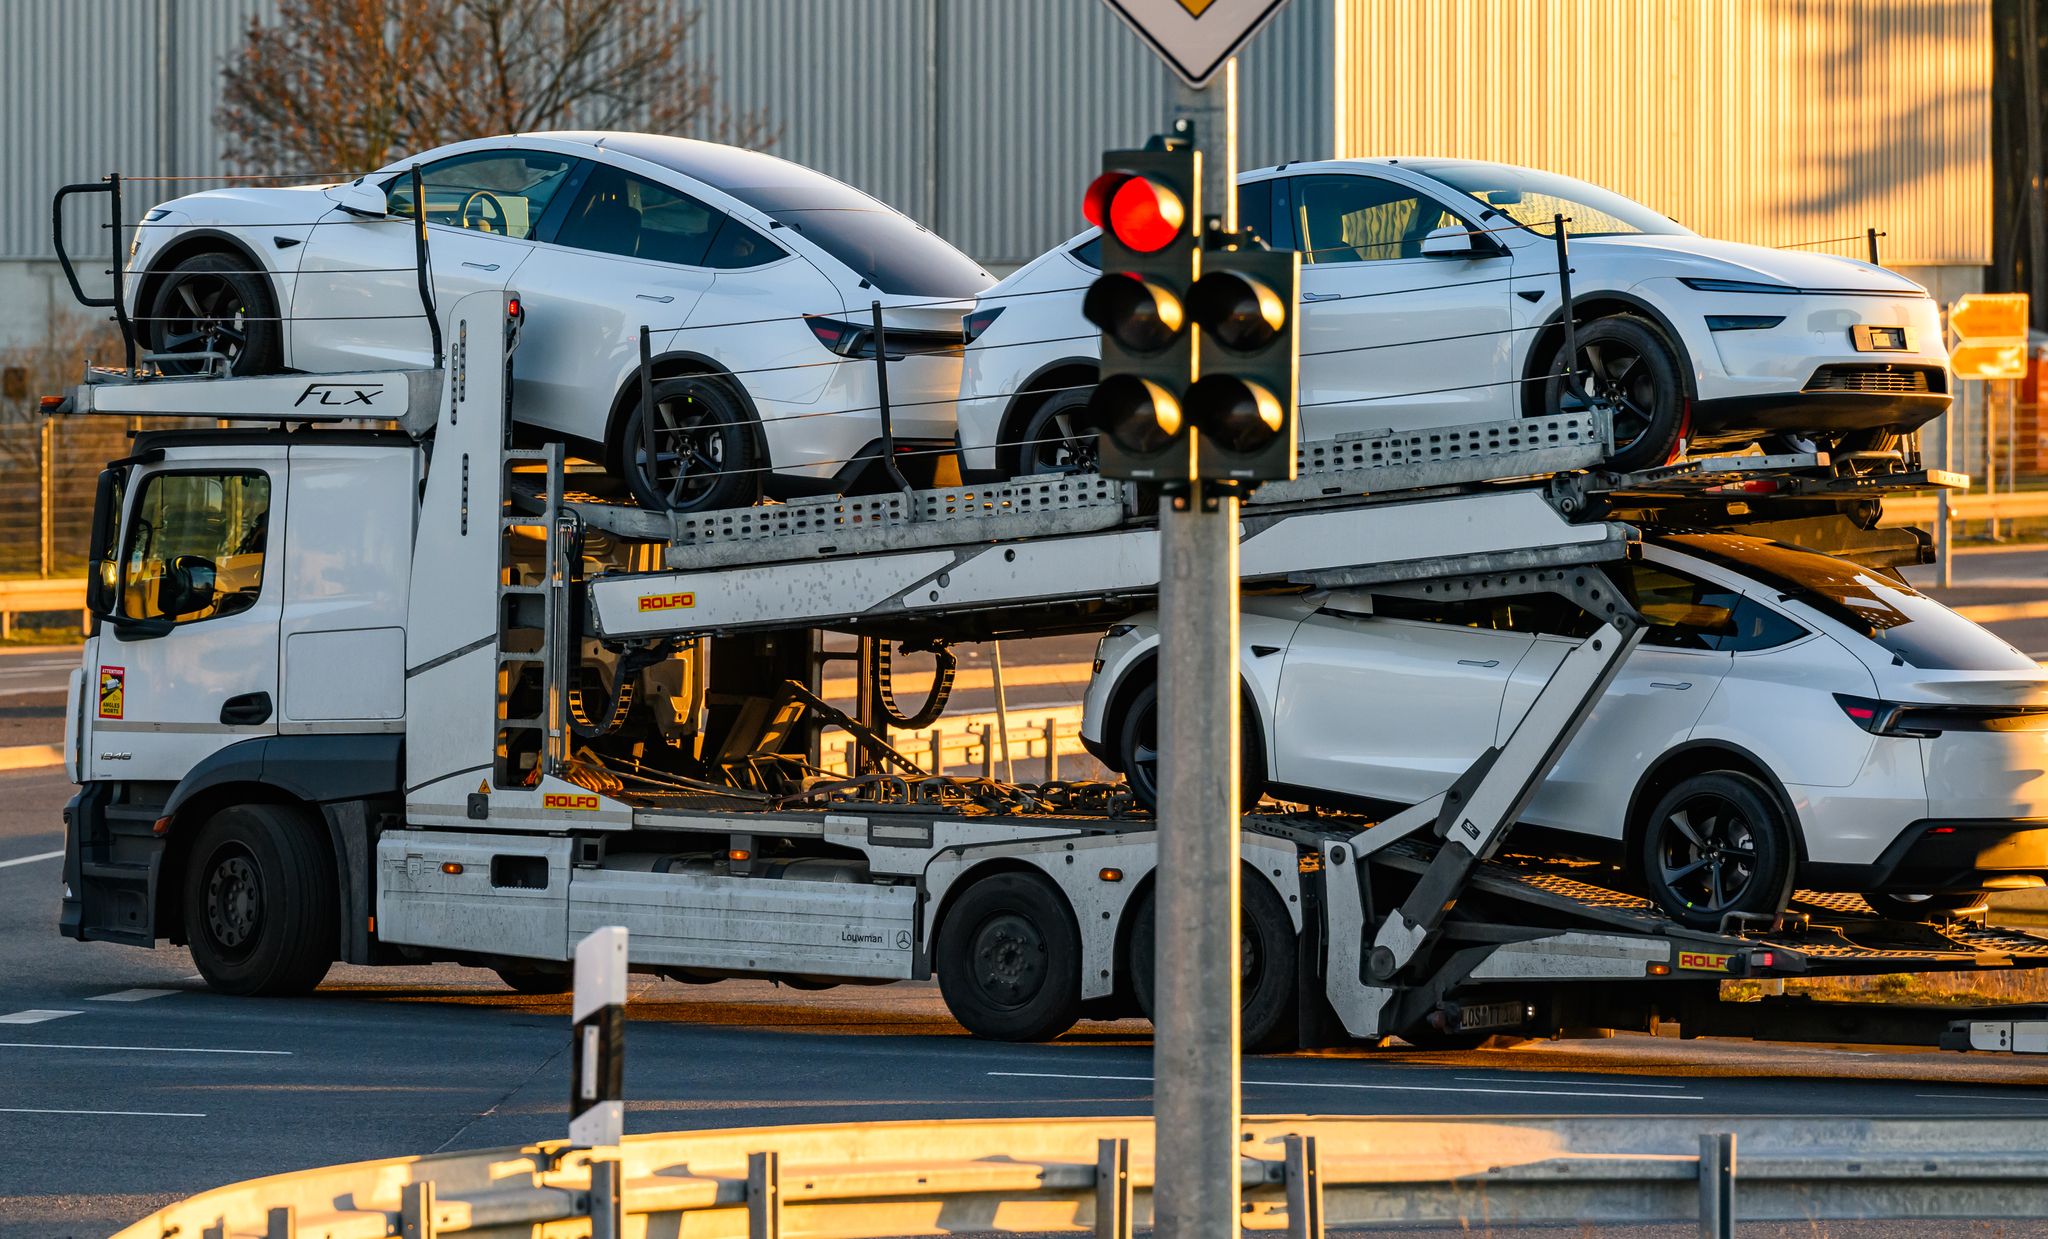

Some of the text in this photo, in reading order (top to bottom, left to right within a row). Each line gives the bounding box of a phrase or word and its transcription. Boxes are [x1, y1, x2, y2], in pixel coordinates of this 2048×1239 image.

[294, 383, 384, 407] FLX
[640, 594, 693, 610] ROLFO
[545, 795, 598, 808] ROLFO
[841, 931, 883, 943] Louwman
[1681, 954, 1727, 968] ROLF
